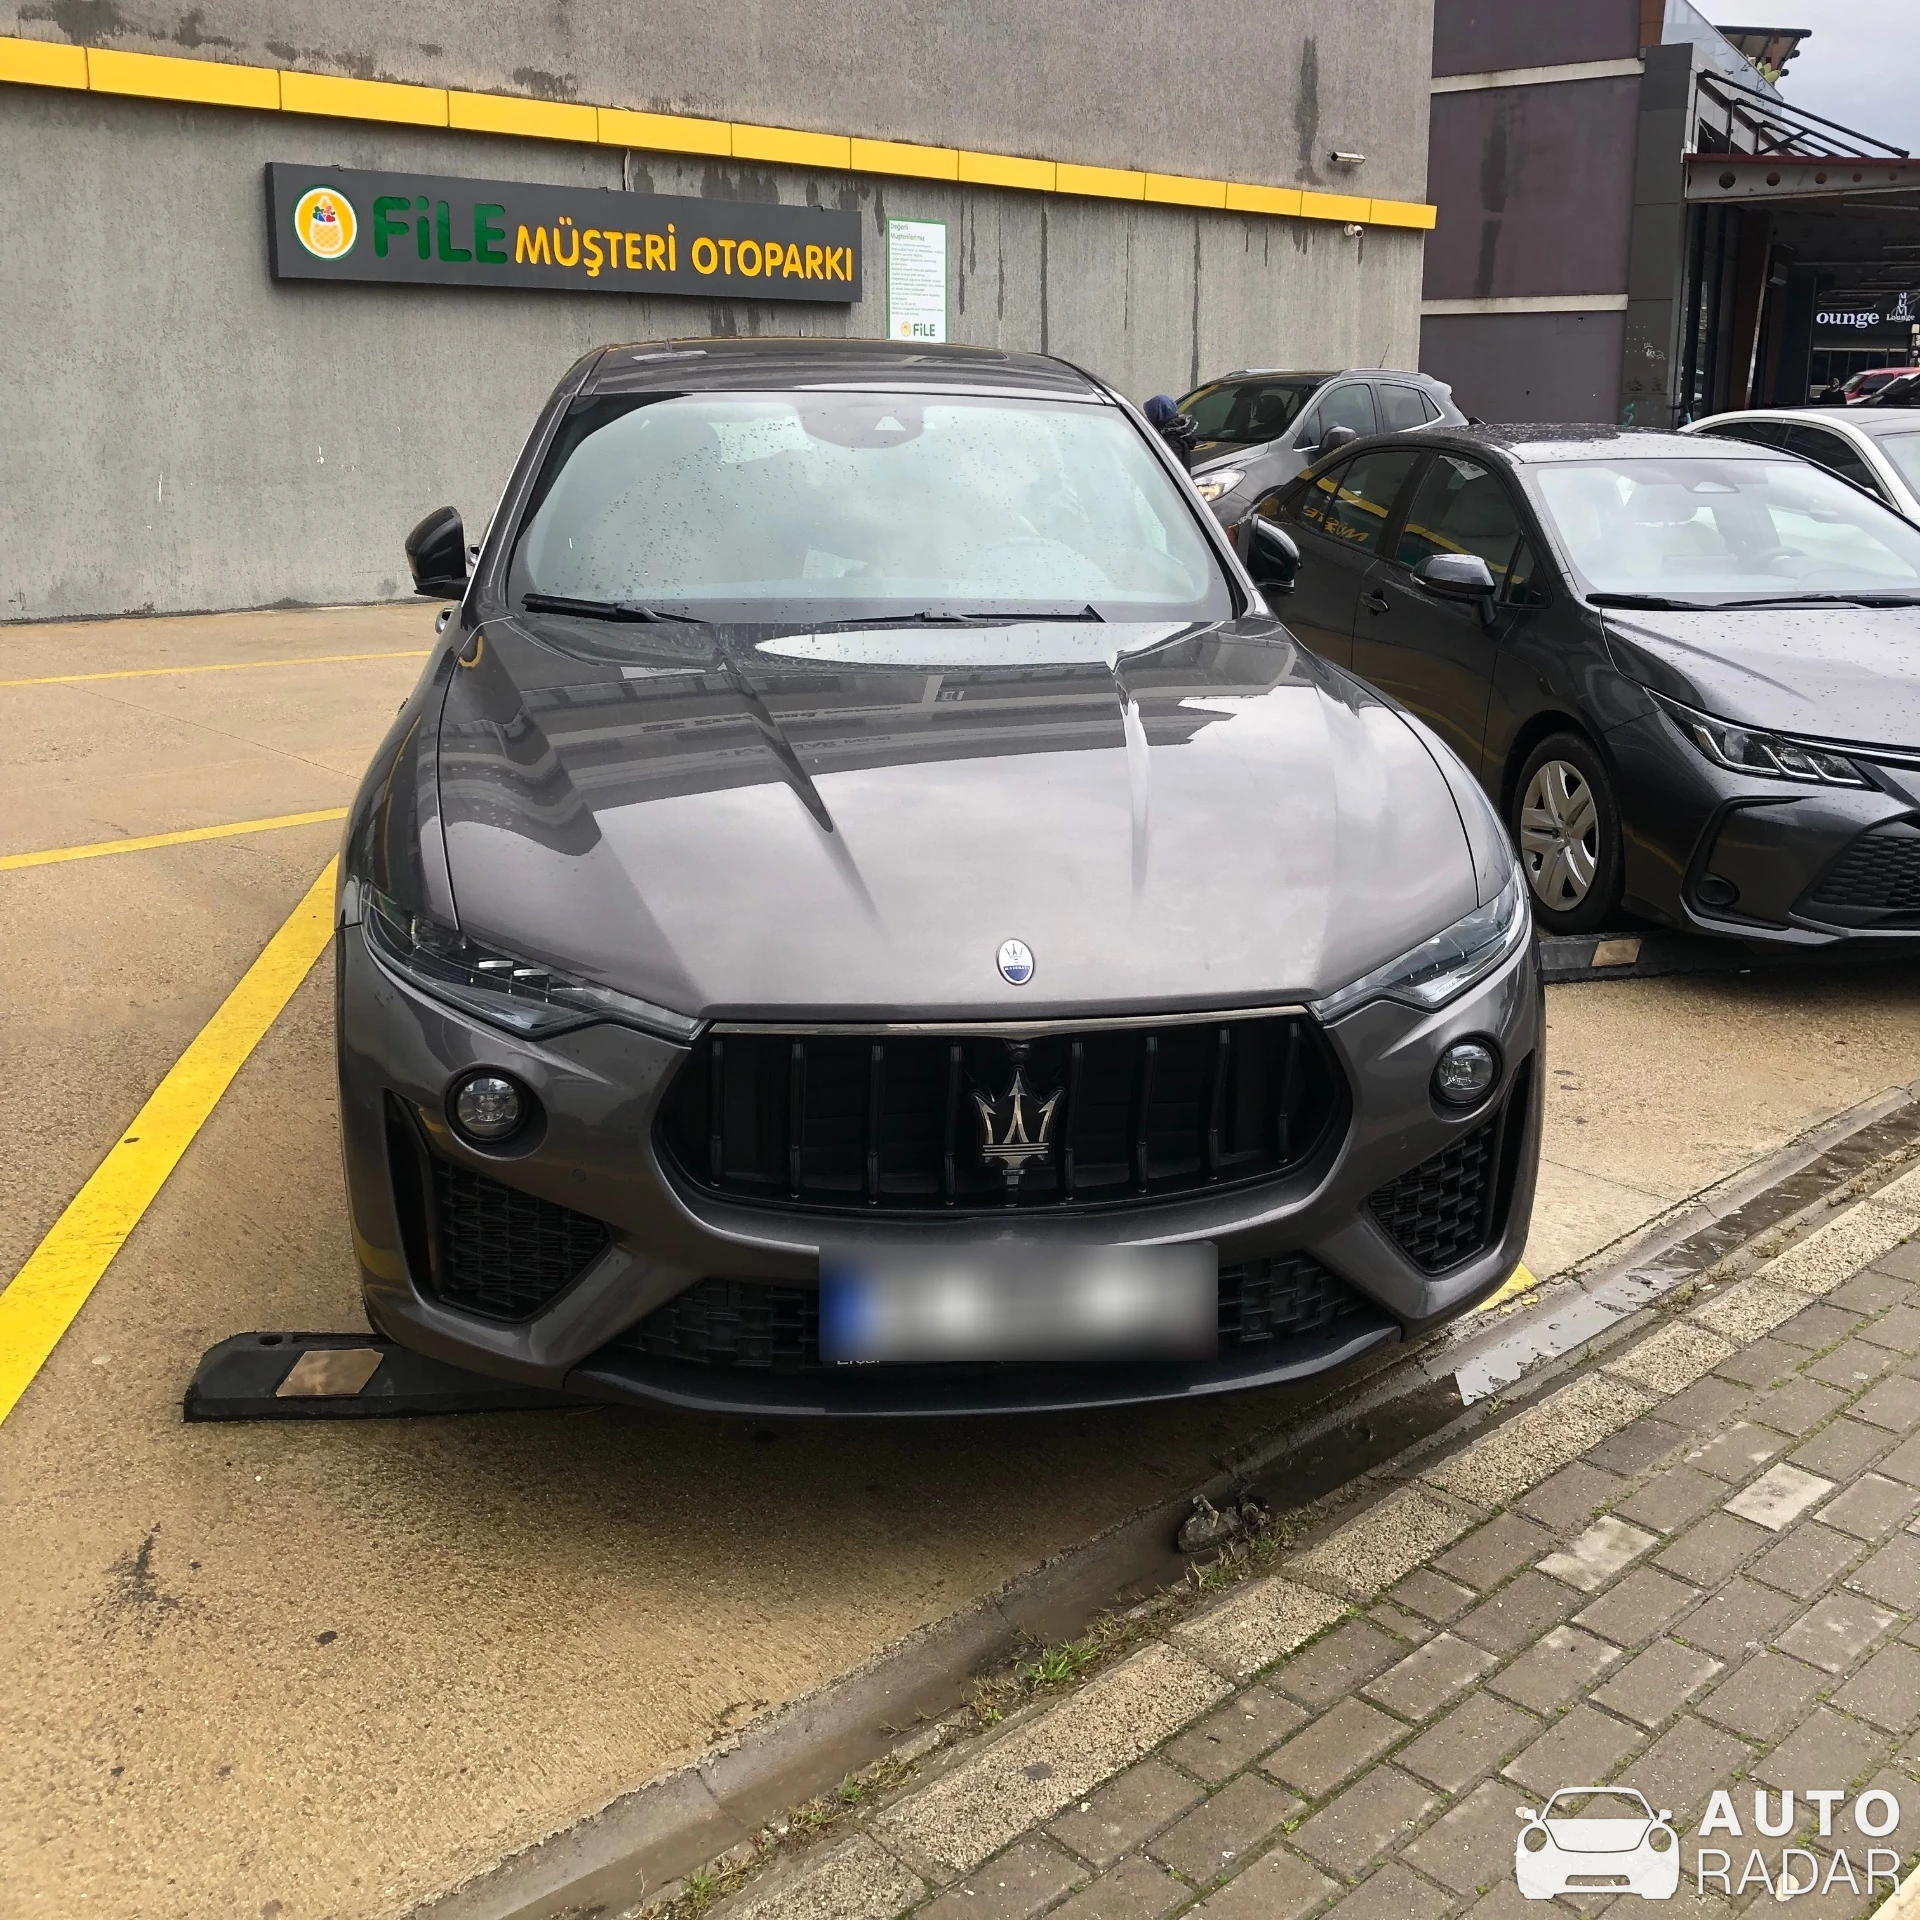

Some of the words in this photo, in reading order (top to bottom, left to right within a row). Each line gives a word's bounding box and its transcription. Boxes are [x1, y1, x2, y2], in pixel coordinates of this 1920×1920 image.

[515, 216, 676, 277] MÜŞTERİ
[692, 237, 853, 282] OTOPARKI
[1816, 312, 1879, 328] ounge
